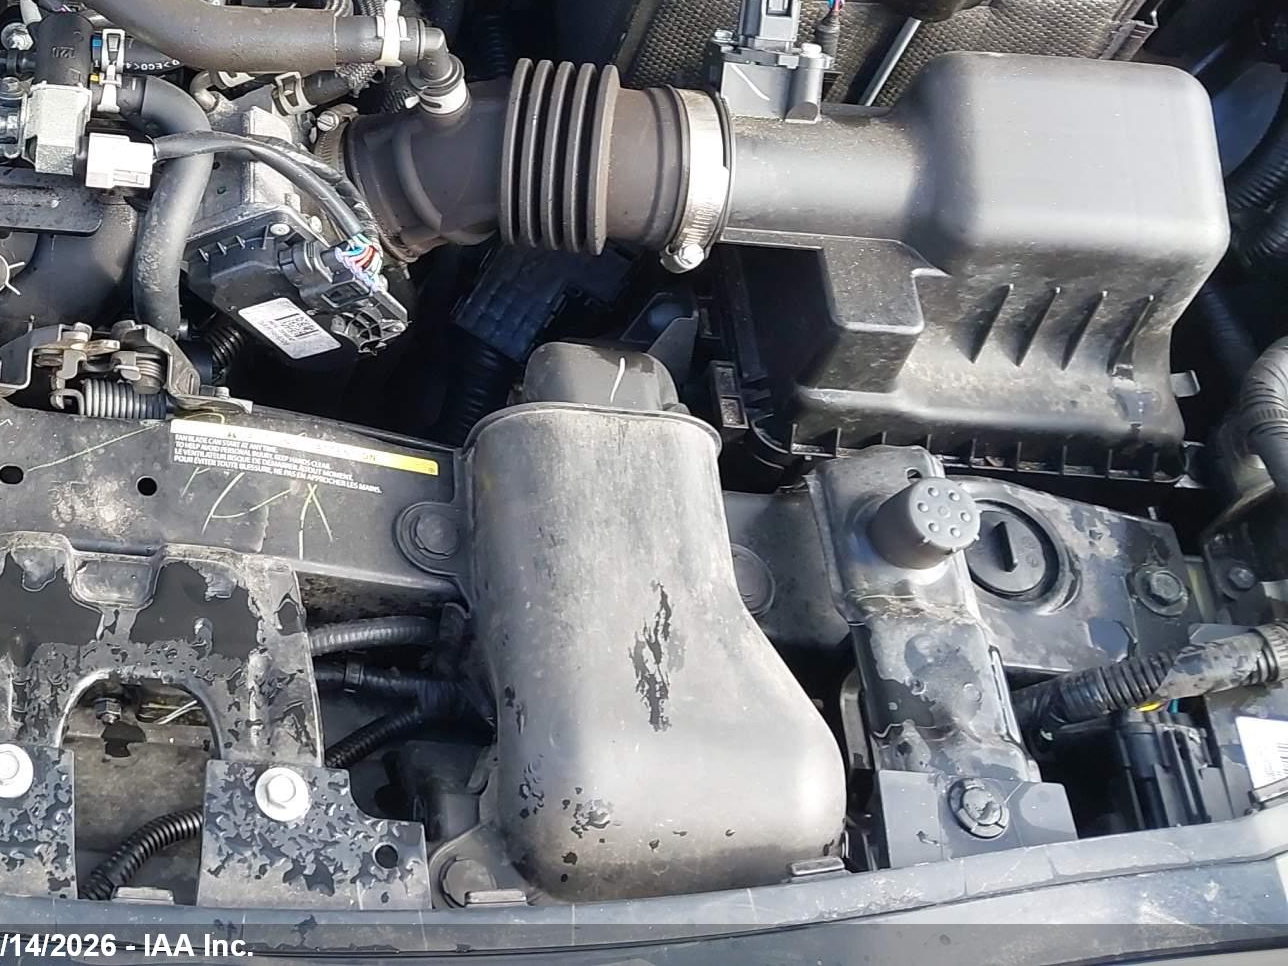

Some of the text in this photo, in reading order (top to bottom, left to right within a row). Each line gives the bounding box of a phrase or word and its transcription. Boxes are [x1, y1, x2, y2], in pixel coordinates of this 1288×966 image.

[184, 441, 200, 450] HELP
[207, 437, 221, 445] CAN
[222, 439, 240, 448] START
[174, 447, 182, 455] LE
[183, 447, 226, 461] VENTILATEUR
[173, 454, 193, 463] POUR
[216, 459, 238, 469] TOUTE
[306, 473, 346, 486] APPROCHER
[346, 480, 358, 488] LES
